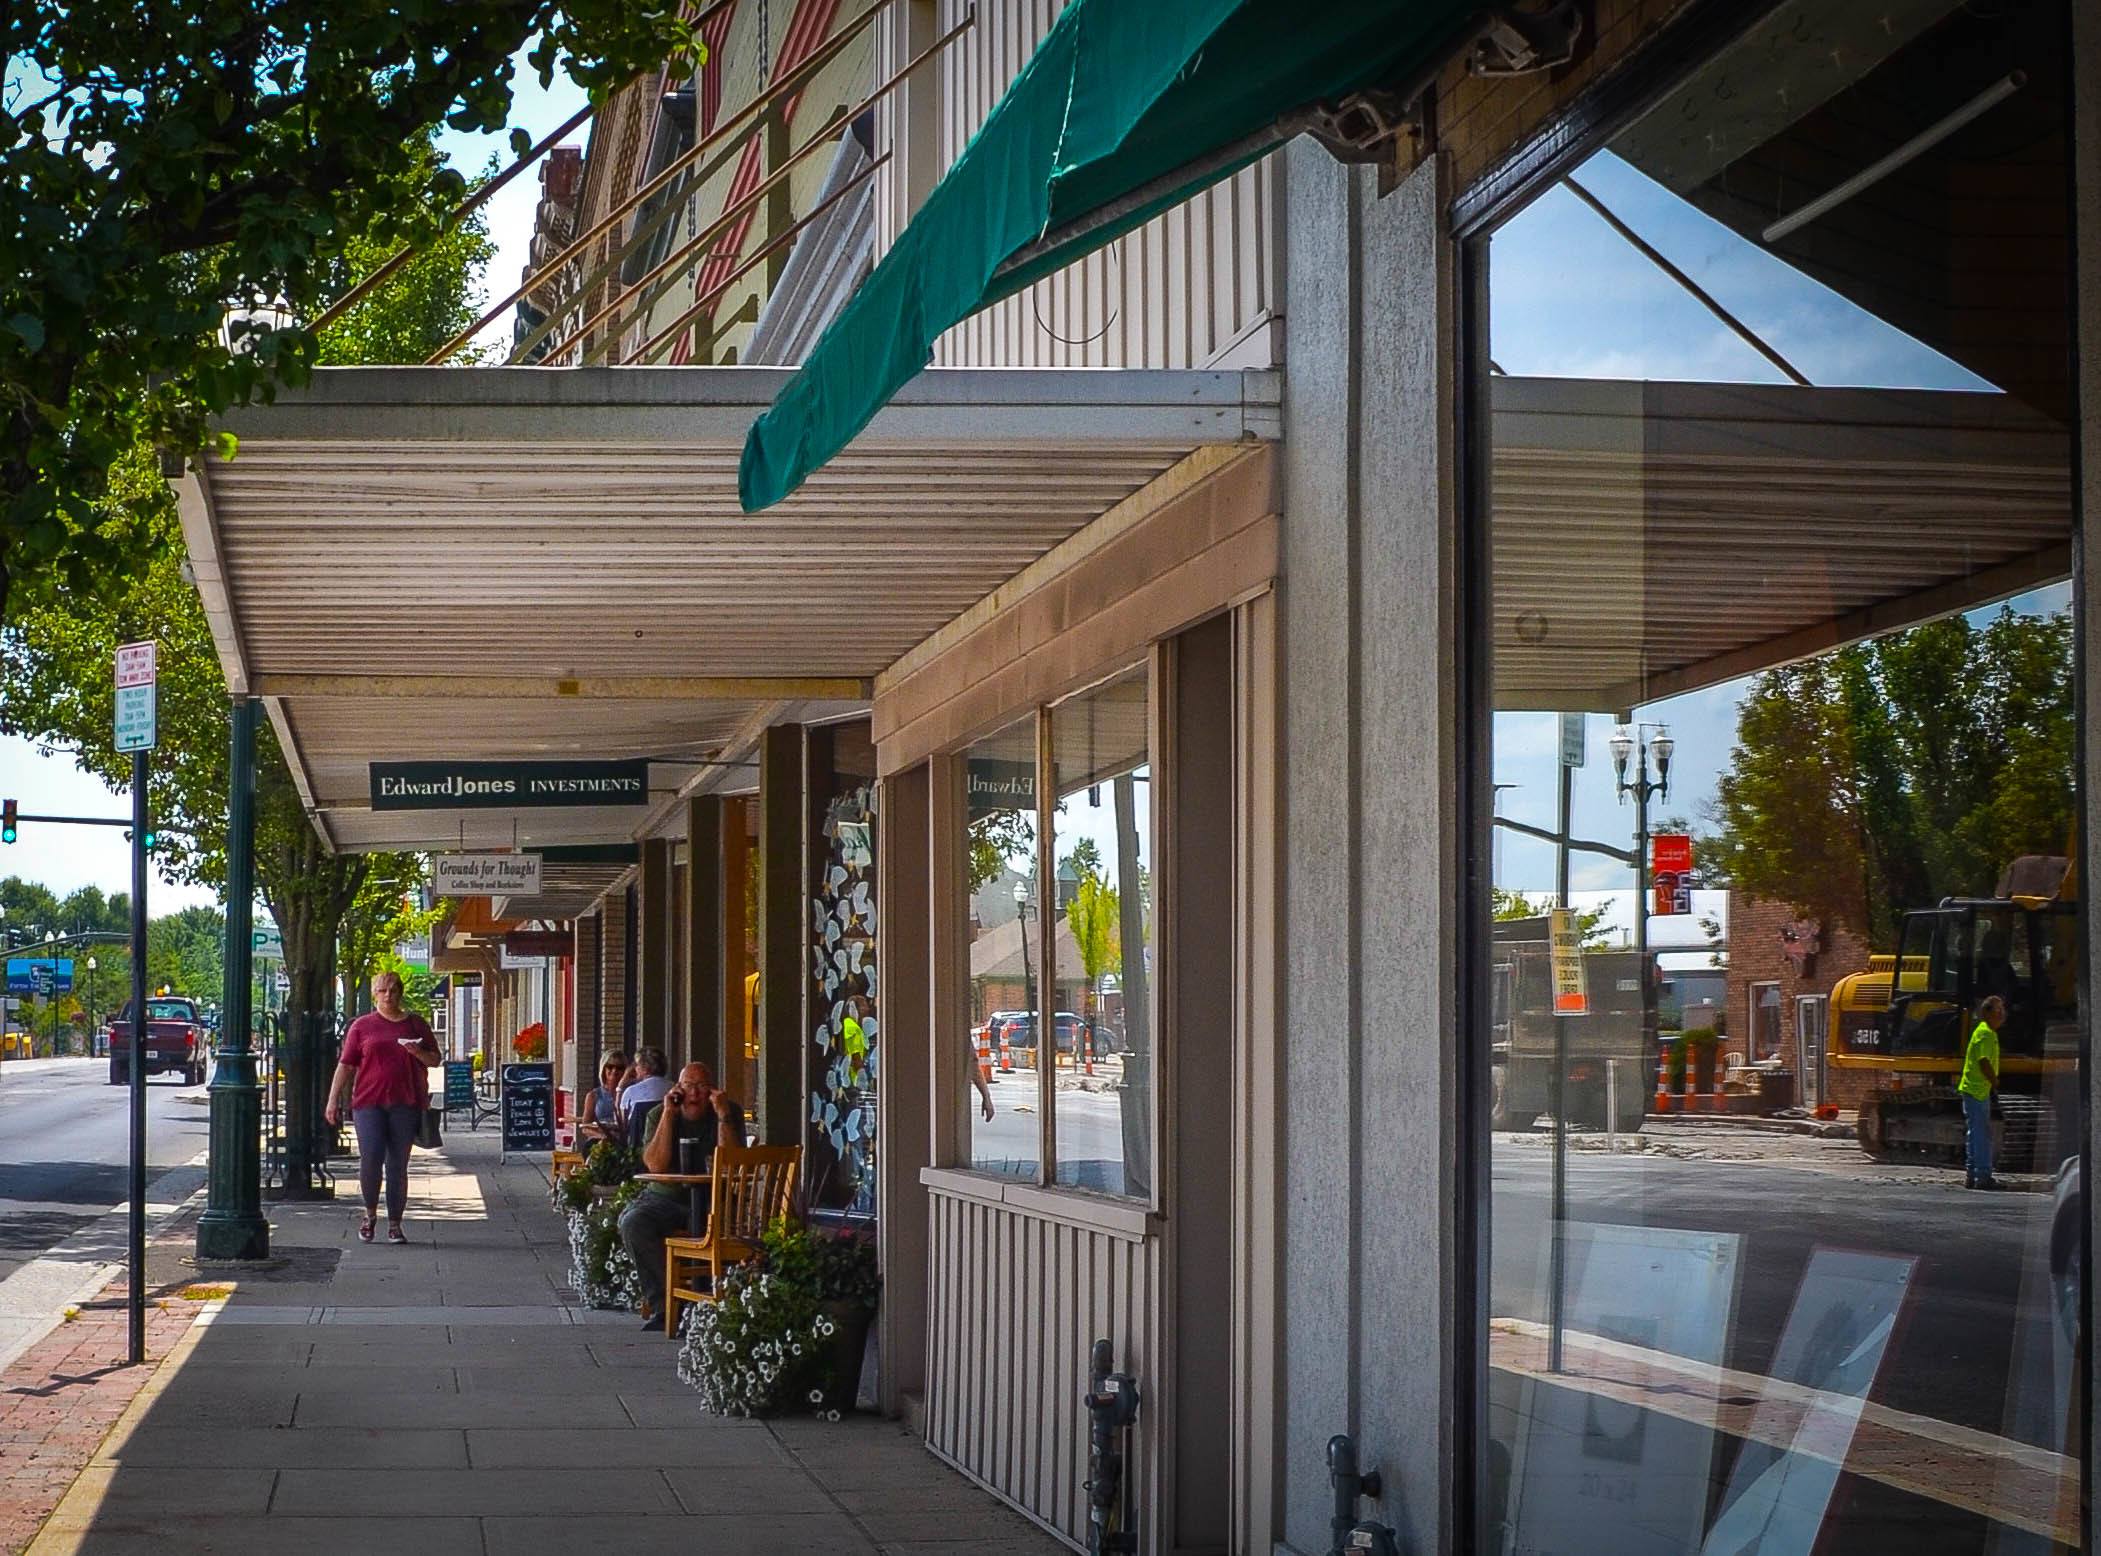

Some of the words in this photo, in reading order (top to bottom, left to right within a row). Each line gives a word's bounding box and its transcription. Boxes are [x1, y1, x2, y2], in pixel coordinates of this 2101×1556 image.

[531, 778, 641, 793] INVESTMENTS
[440, 860, 479, 876] Grounds
[480, 860, 495, 879] for
[498, 860, 536, 879] Thought
[254, 932, 268, 951] P
